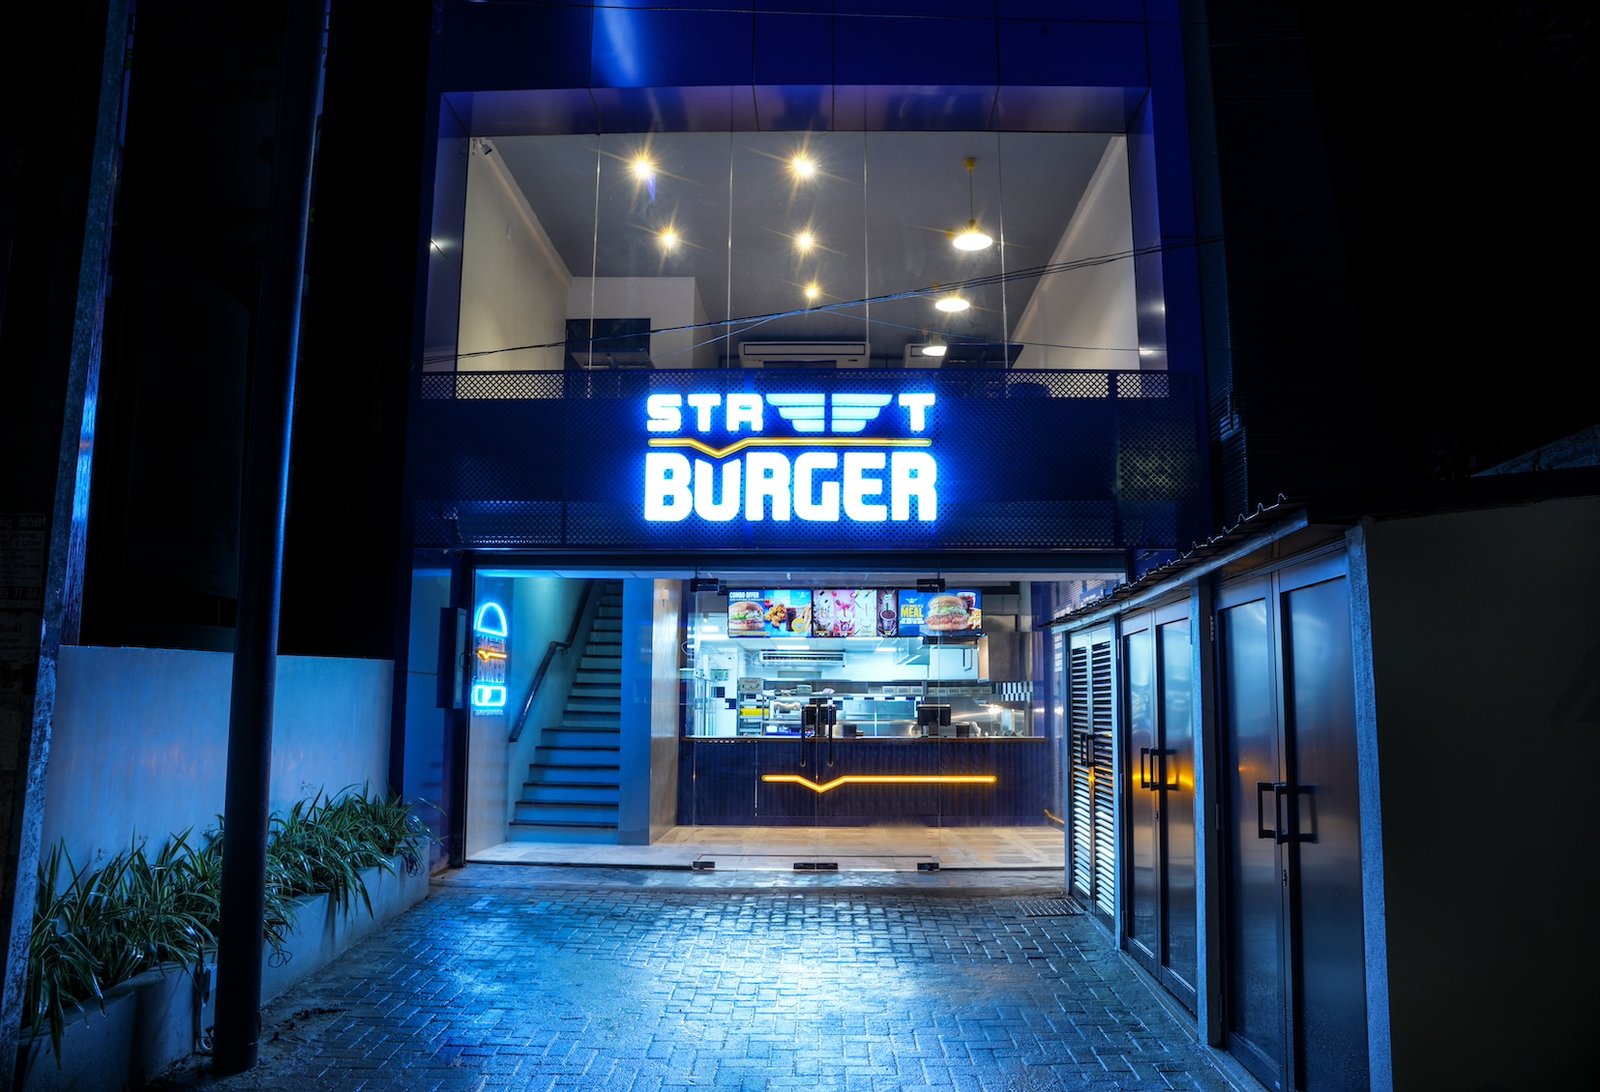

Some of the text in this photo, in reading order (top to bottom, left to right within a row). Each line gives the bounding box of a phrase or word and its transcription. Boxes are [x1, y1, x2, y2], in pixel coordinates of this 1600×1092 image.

[644, 452, 938, 522] BURGER
[729, 591, 760, 599] COMBO OFFER
[901, 607, 924, 618] MEAL
